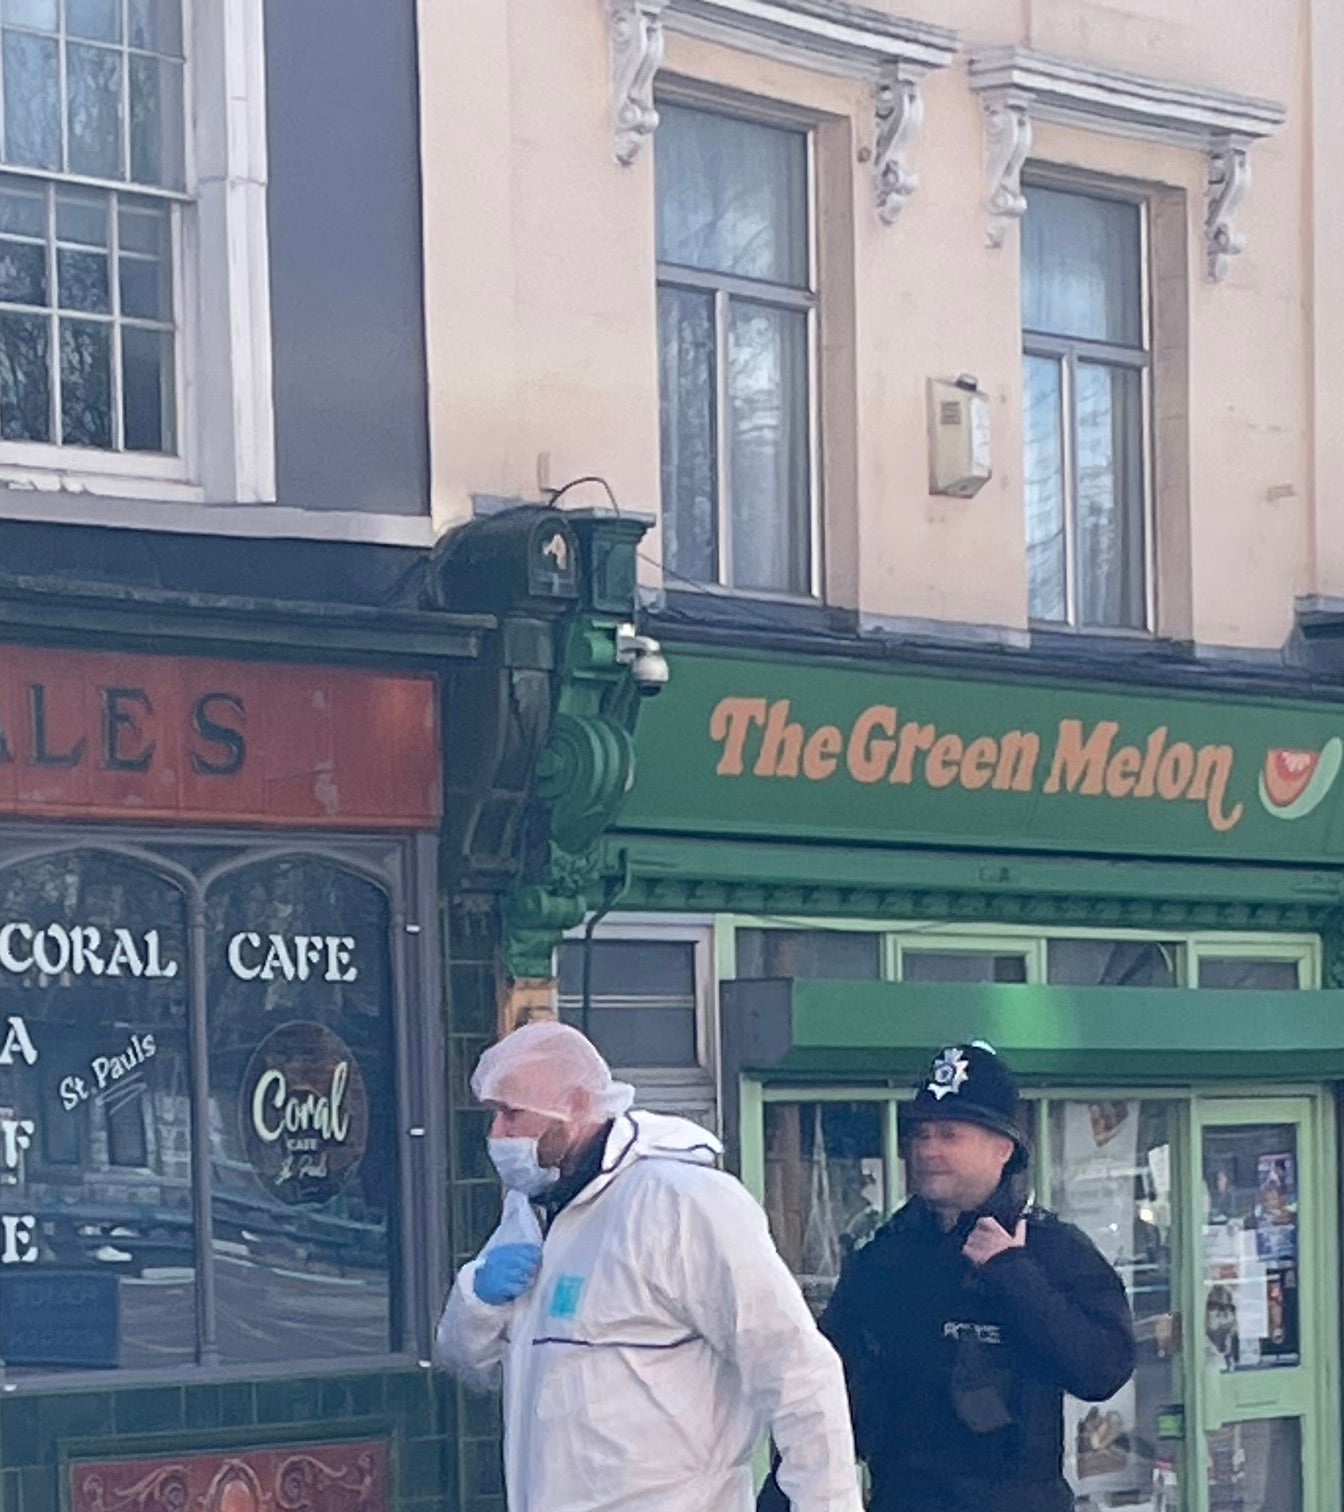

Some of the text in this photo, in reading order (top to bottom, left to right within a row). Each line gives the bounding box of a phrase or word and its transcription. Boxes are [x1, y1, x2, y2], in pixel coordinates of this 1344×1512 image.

[846, 705, 1041, 792] Green
[1042, 718, 1244, 832] Melon
[227, 931, 358, 983] CAFE
[92, 1033, 157, 1090] Pauls
[253, 1061, 350, 1143] Coral
